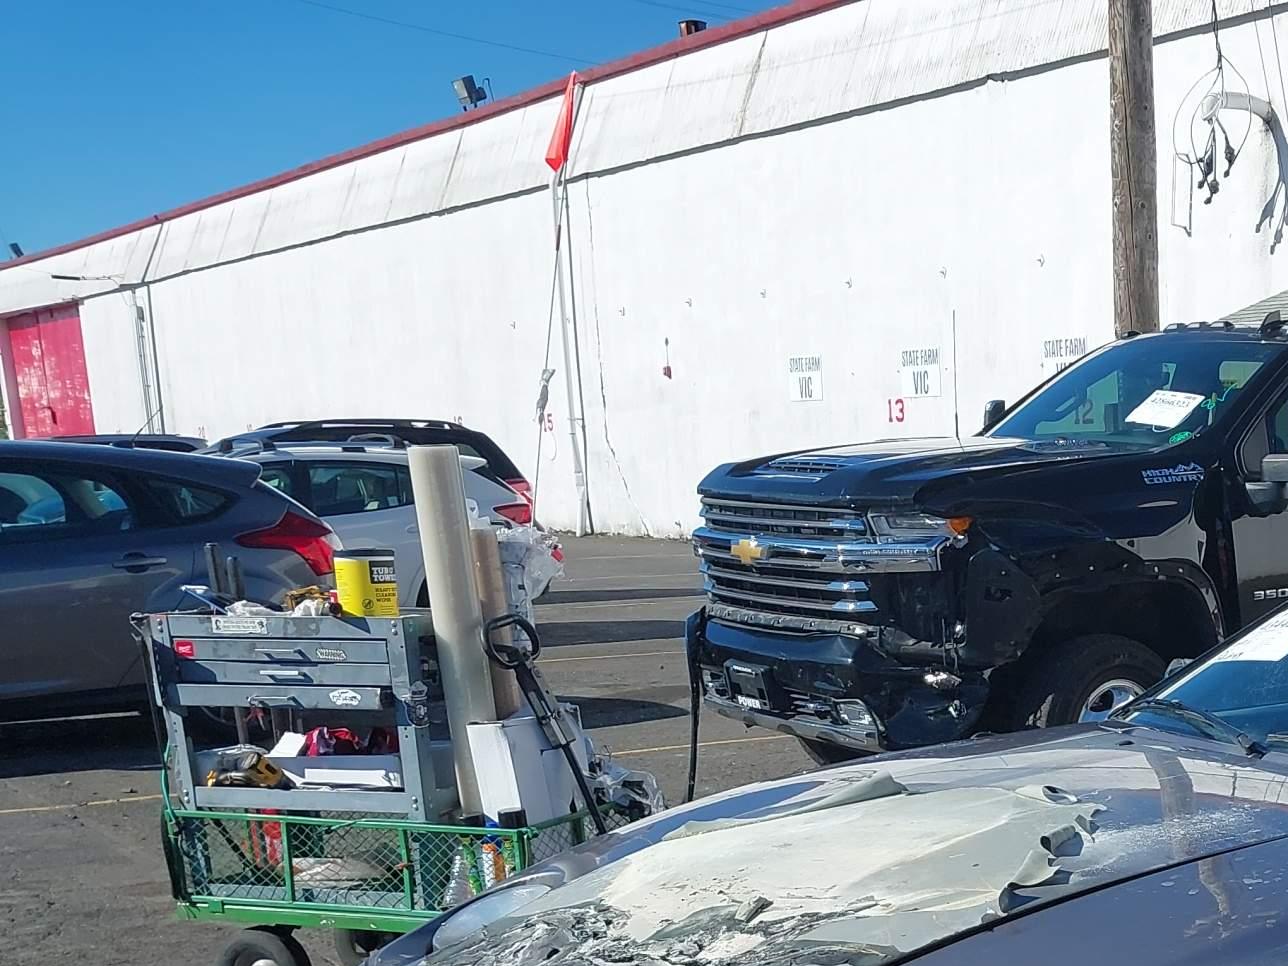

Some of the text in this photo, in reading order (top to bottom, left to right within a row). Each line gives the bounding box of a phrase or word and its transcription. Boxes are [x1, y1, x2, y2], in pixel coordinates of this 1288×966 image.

[901, 348, 939, 367] STATE FARM
[1044, 337, 1086, 358] STATE FARM
[789, 356, 820, 373] STATE FARM
[799, 376, 813, 399] VIC
[912, 370, 929, 395] VIC
[887, 398, 905, 423] 13
[1073, 398, 1094, 424] 12
[1141, 468, 1174, 477] HIGH
[1144, 474, 1204, 485] COUNTRY
